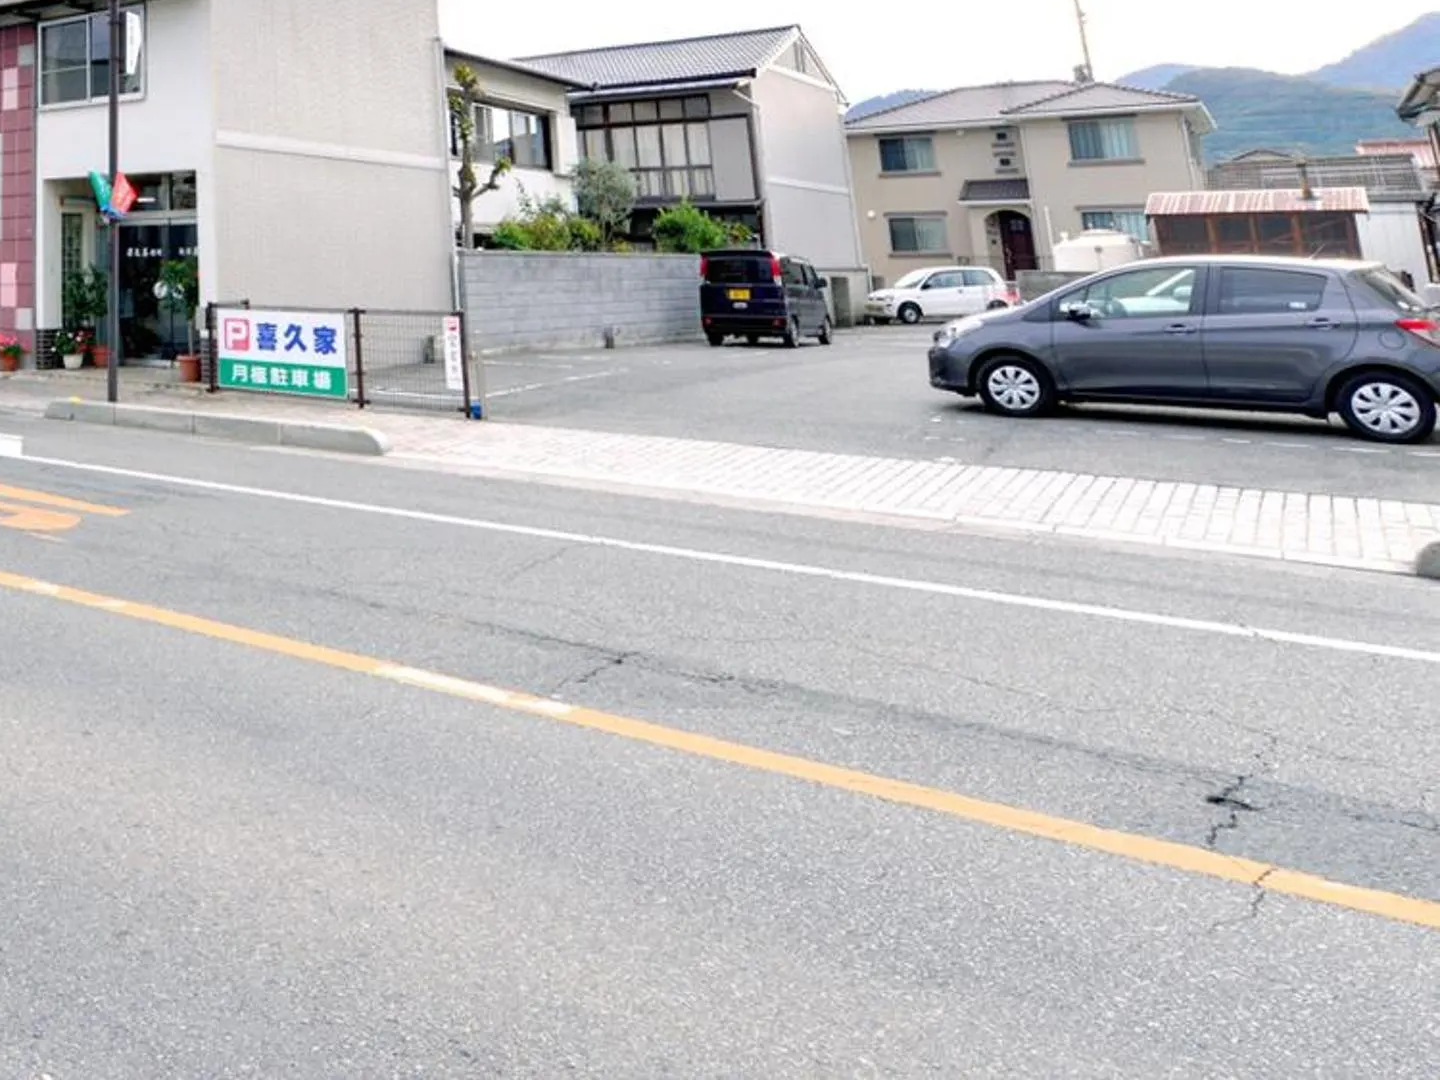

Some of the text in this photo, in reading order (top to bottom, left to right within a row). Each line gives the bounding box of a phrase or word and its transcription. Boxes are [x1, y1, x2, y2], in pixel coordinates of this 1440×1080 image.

[256, 322, 338, 355] 喜久家
[231, 363, 333, 389] 月極駐車場
